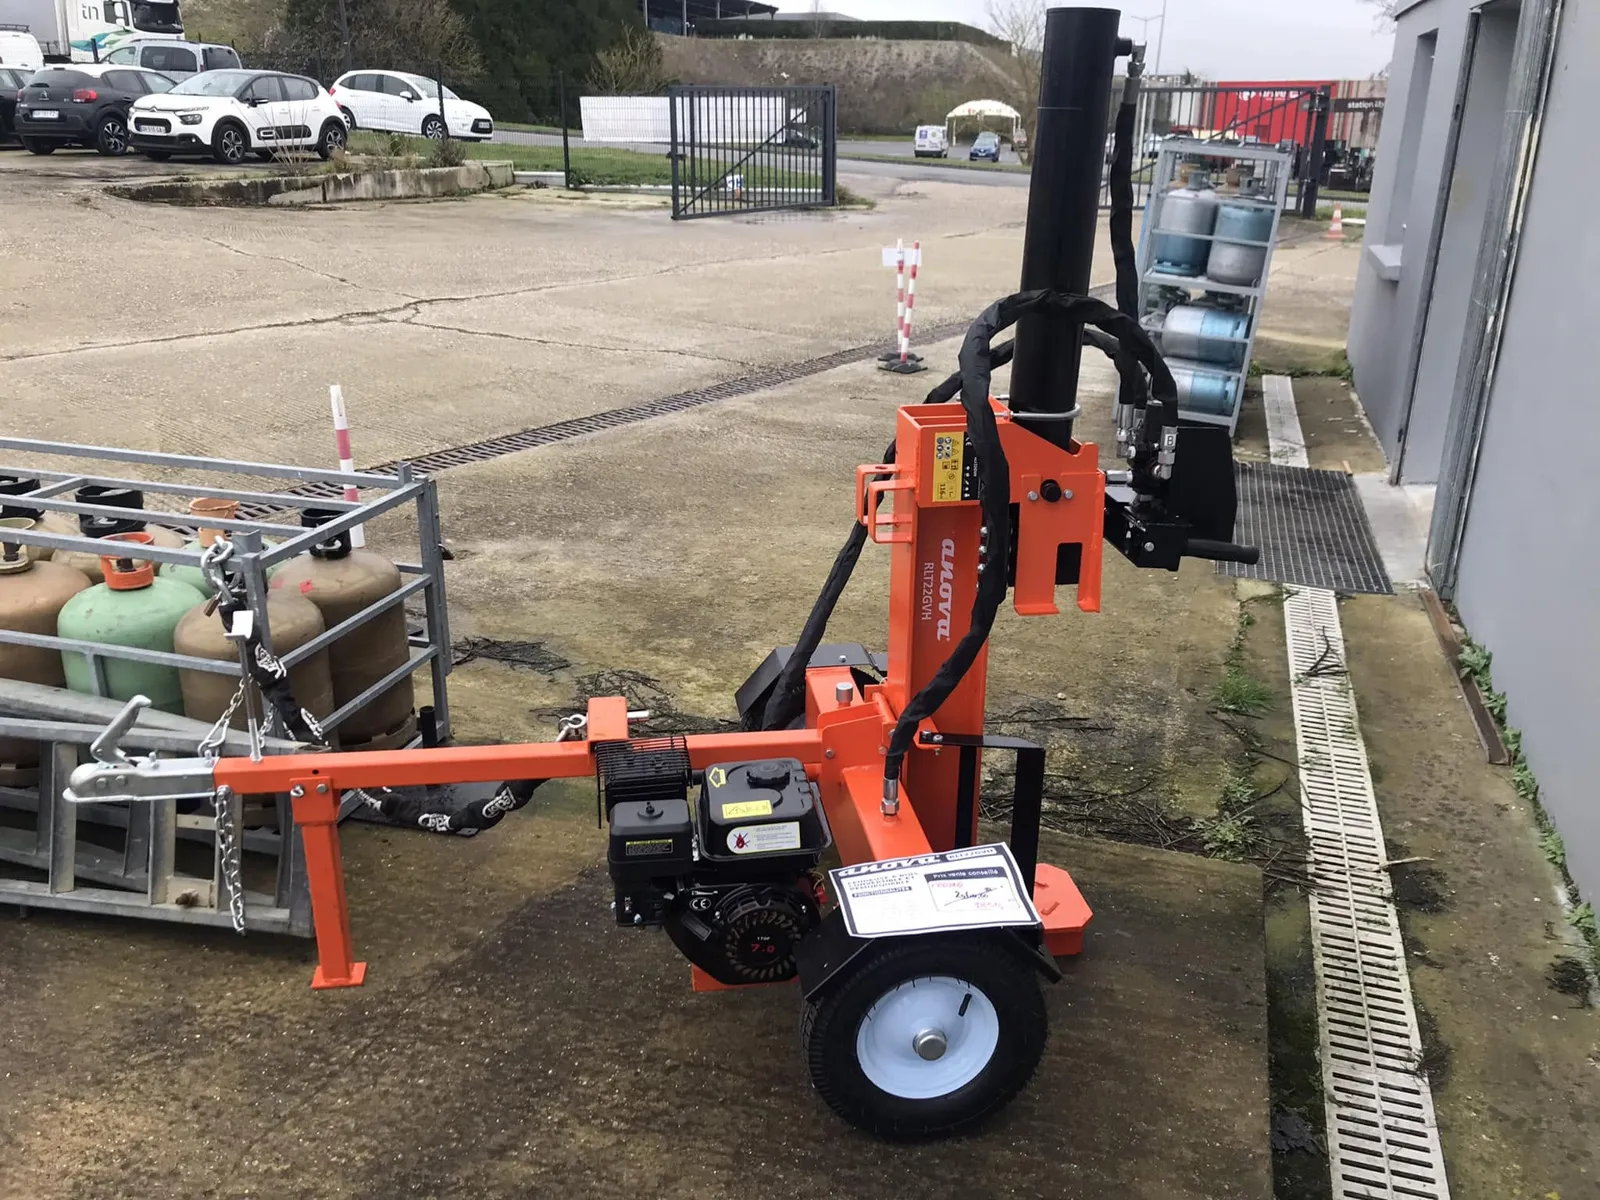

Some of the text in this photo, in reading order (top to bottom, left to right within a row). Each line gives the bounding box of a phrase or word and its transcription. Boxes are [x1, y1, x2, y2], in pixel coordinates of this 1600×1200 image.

[1168, 436, 1174, 446] B
[922, 562, 934, 620] RLT22GVH
[937, 538, 954, 641] anova
[838, 855, 941, 876] anova
[692, 899, 706, 909] CE
[751, 943, 775, 953] 7.0
